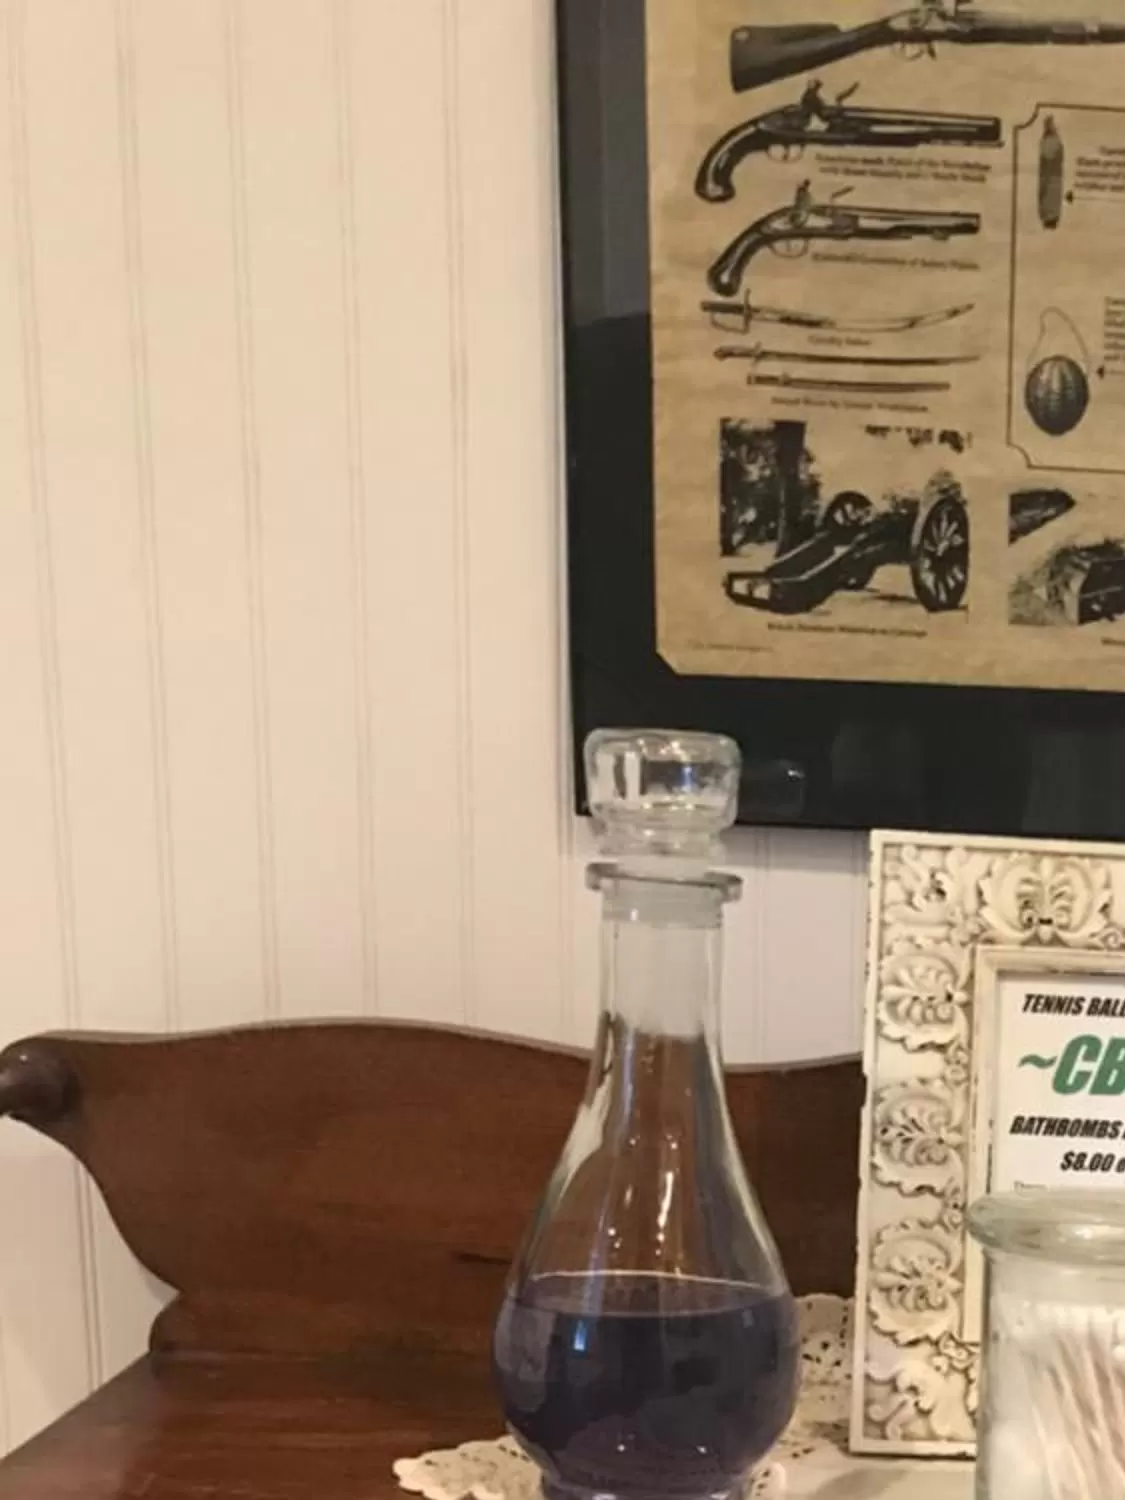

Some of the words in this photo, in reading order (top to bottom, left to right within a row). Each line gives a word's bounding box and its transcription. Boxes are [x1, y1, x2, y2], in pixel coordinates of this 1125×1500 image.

[1022, 993, 1086, 1016] TENNIS
[1010, 1115, 1123, 1140] BATHBOMBS
[1060, 1151, 1115, 1173] $8.00
